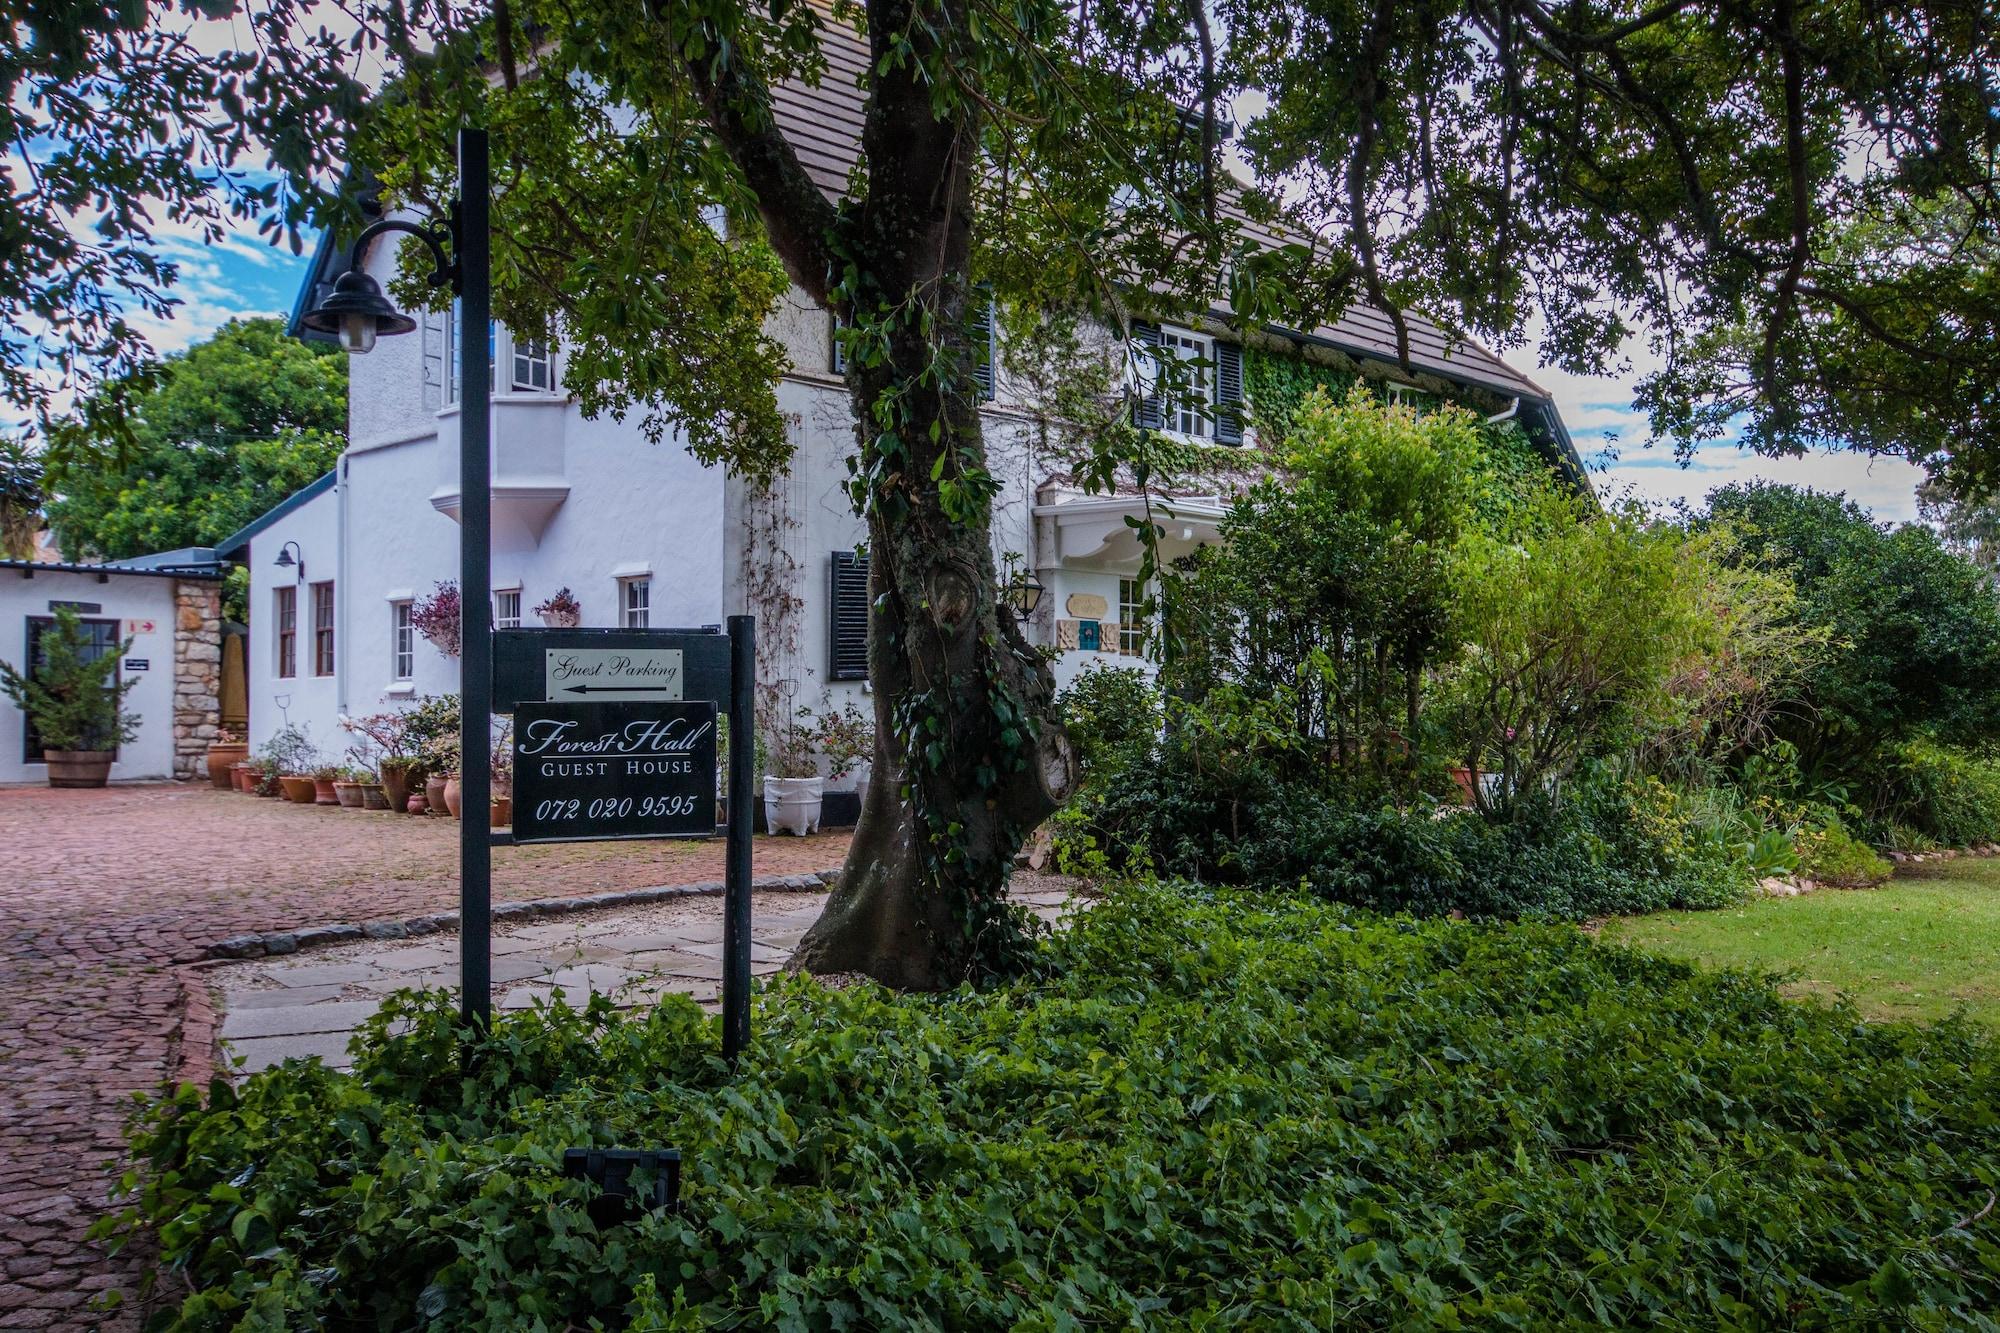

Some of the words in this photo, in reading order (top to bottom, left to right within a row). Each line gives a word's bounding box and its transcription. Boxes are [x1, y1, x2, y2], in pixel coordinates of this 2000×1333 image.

[553, 655, 603, 680] Guest
[608, 655, 677, 683] Parking
[519, 719, 618, 755] Forest
[617, 717, 712, 752] Hall
[541, 762, 608, 777] GUEST
[626, 760, 693, 775] HOUSE
[535, 799, 581, 821] 072
[588, 797, 633, 819] 020
[637, 795, 699, 817] 9595
